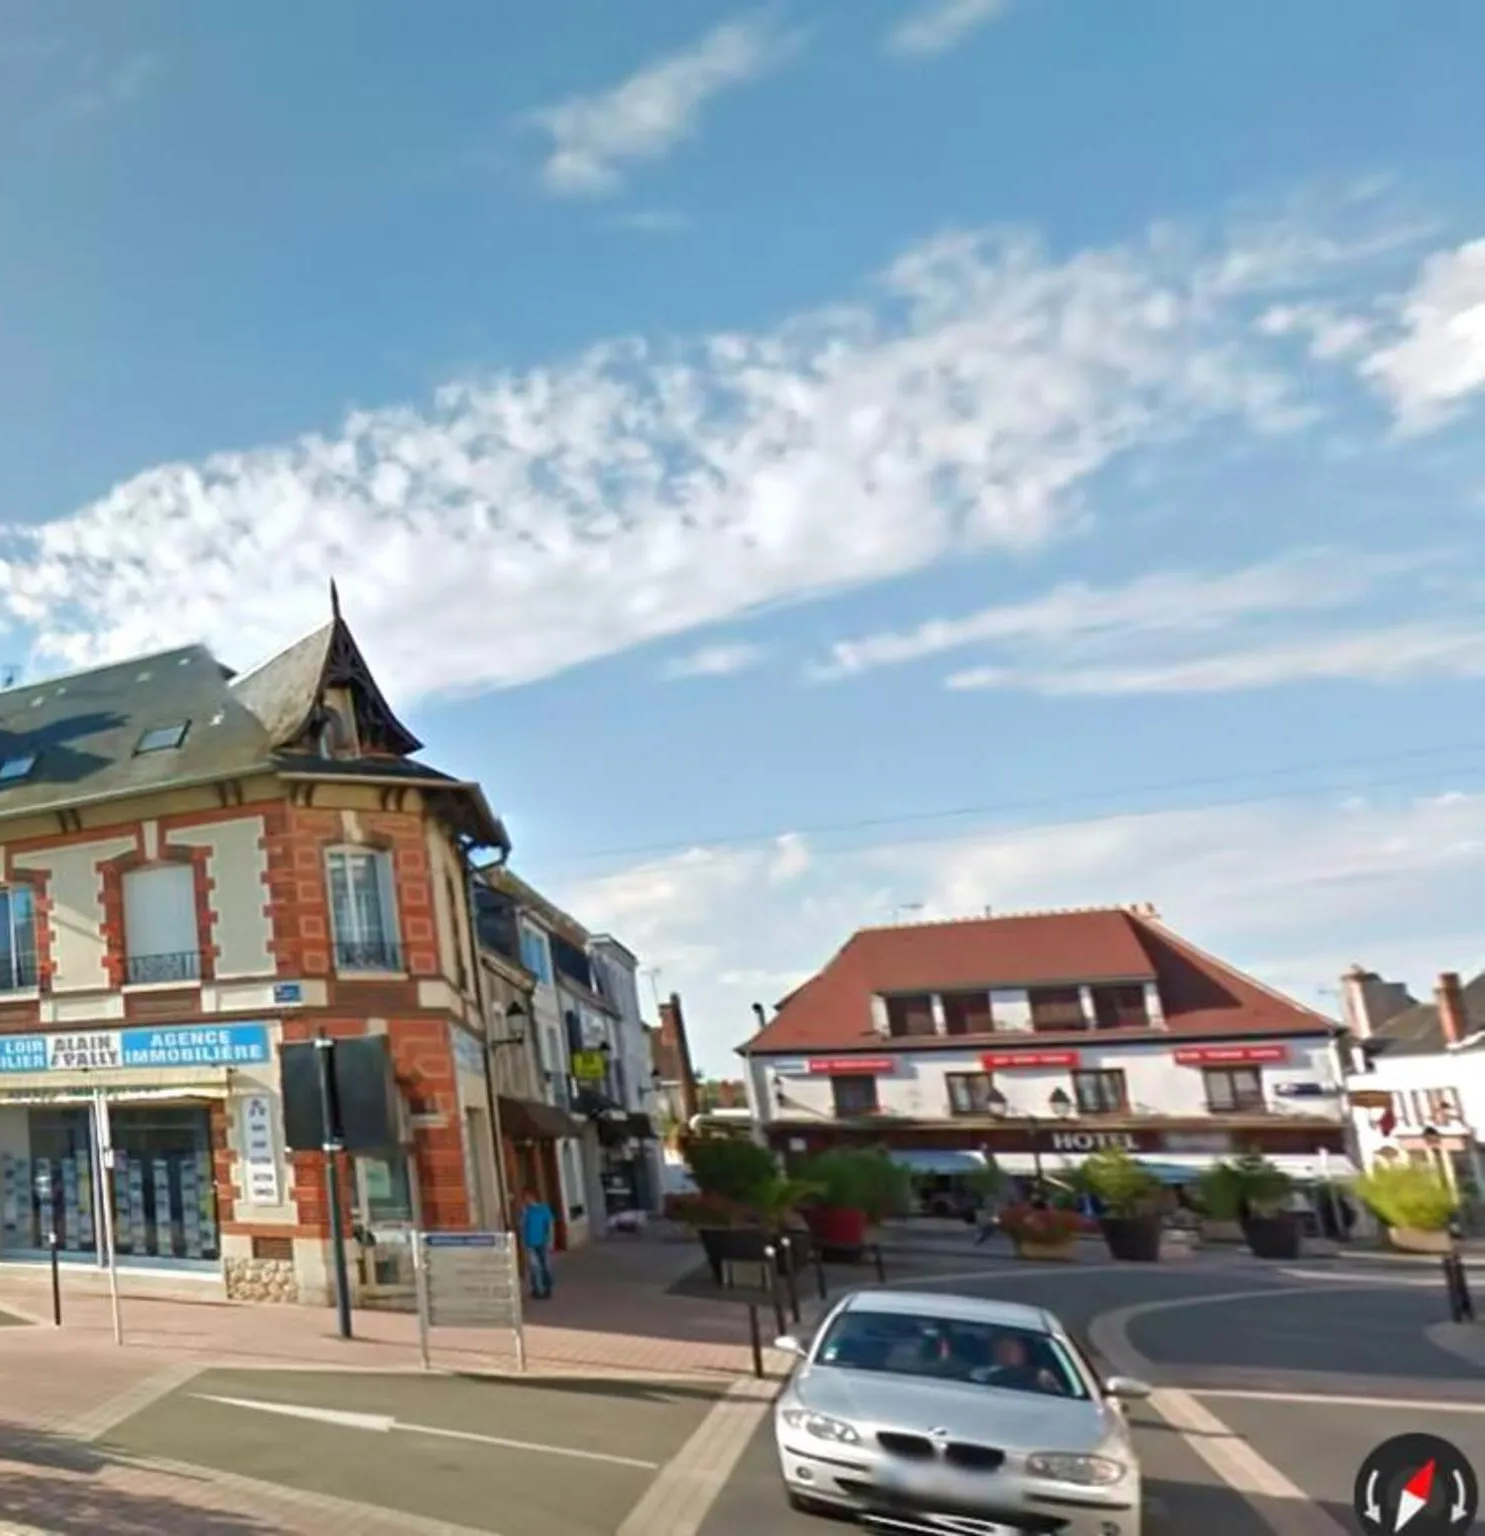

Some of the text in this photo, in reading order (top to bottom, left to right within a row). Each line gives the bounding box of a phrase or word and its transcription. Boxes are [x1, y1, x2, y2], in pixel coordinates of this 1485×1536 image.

[55, 1035, 111, 1051] ALAIN
[150, 1030, 231, 1047] AGENCE
[5, 1040, 44, 1055] LOIR
[1052, 1132, 1140, 1150] HOTEL
